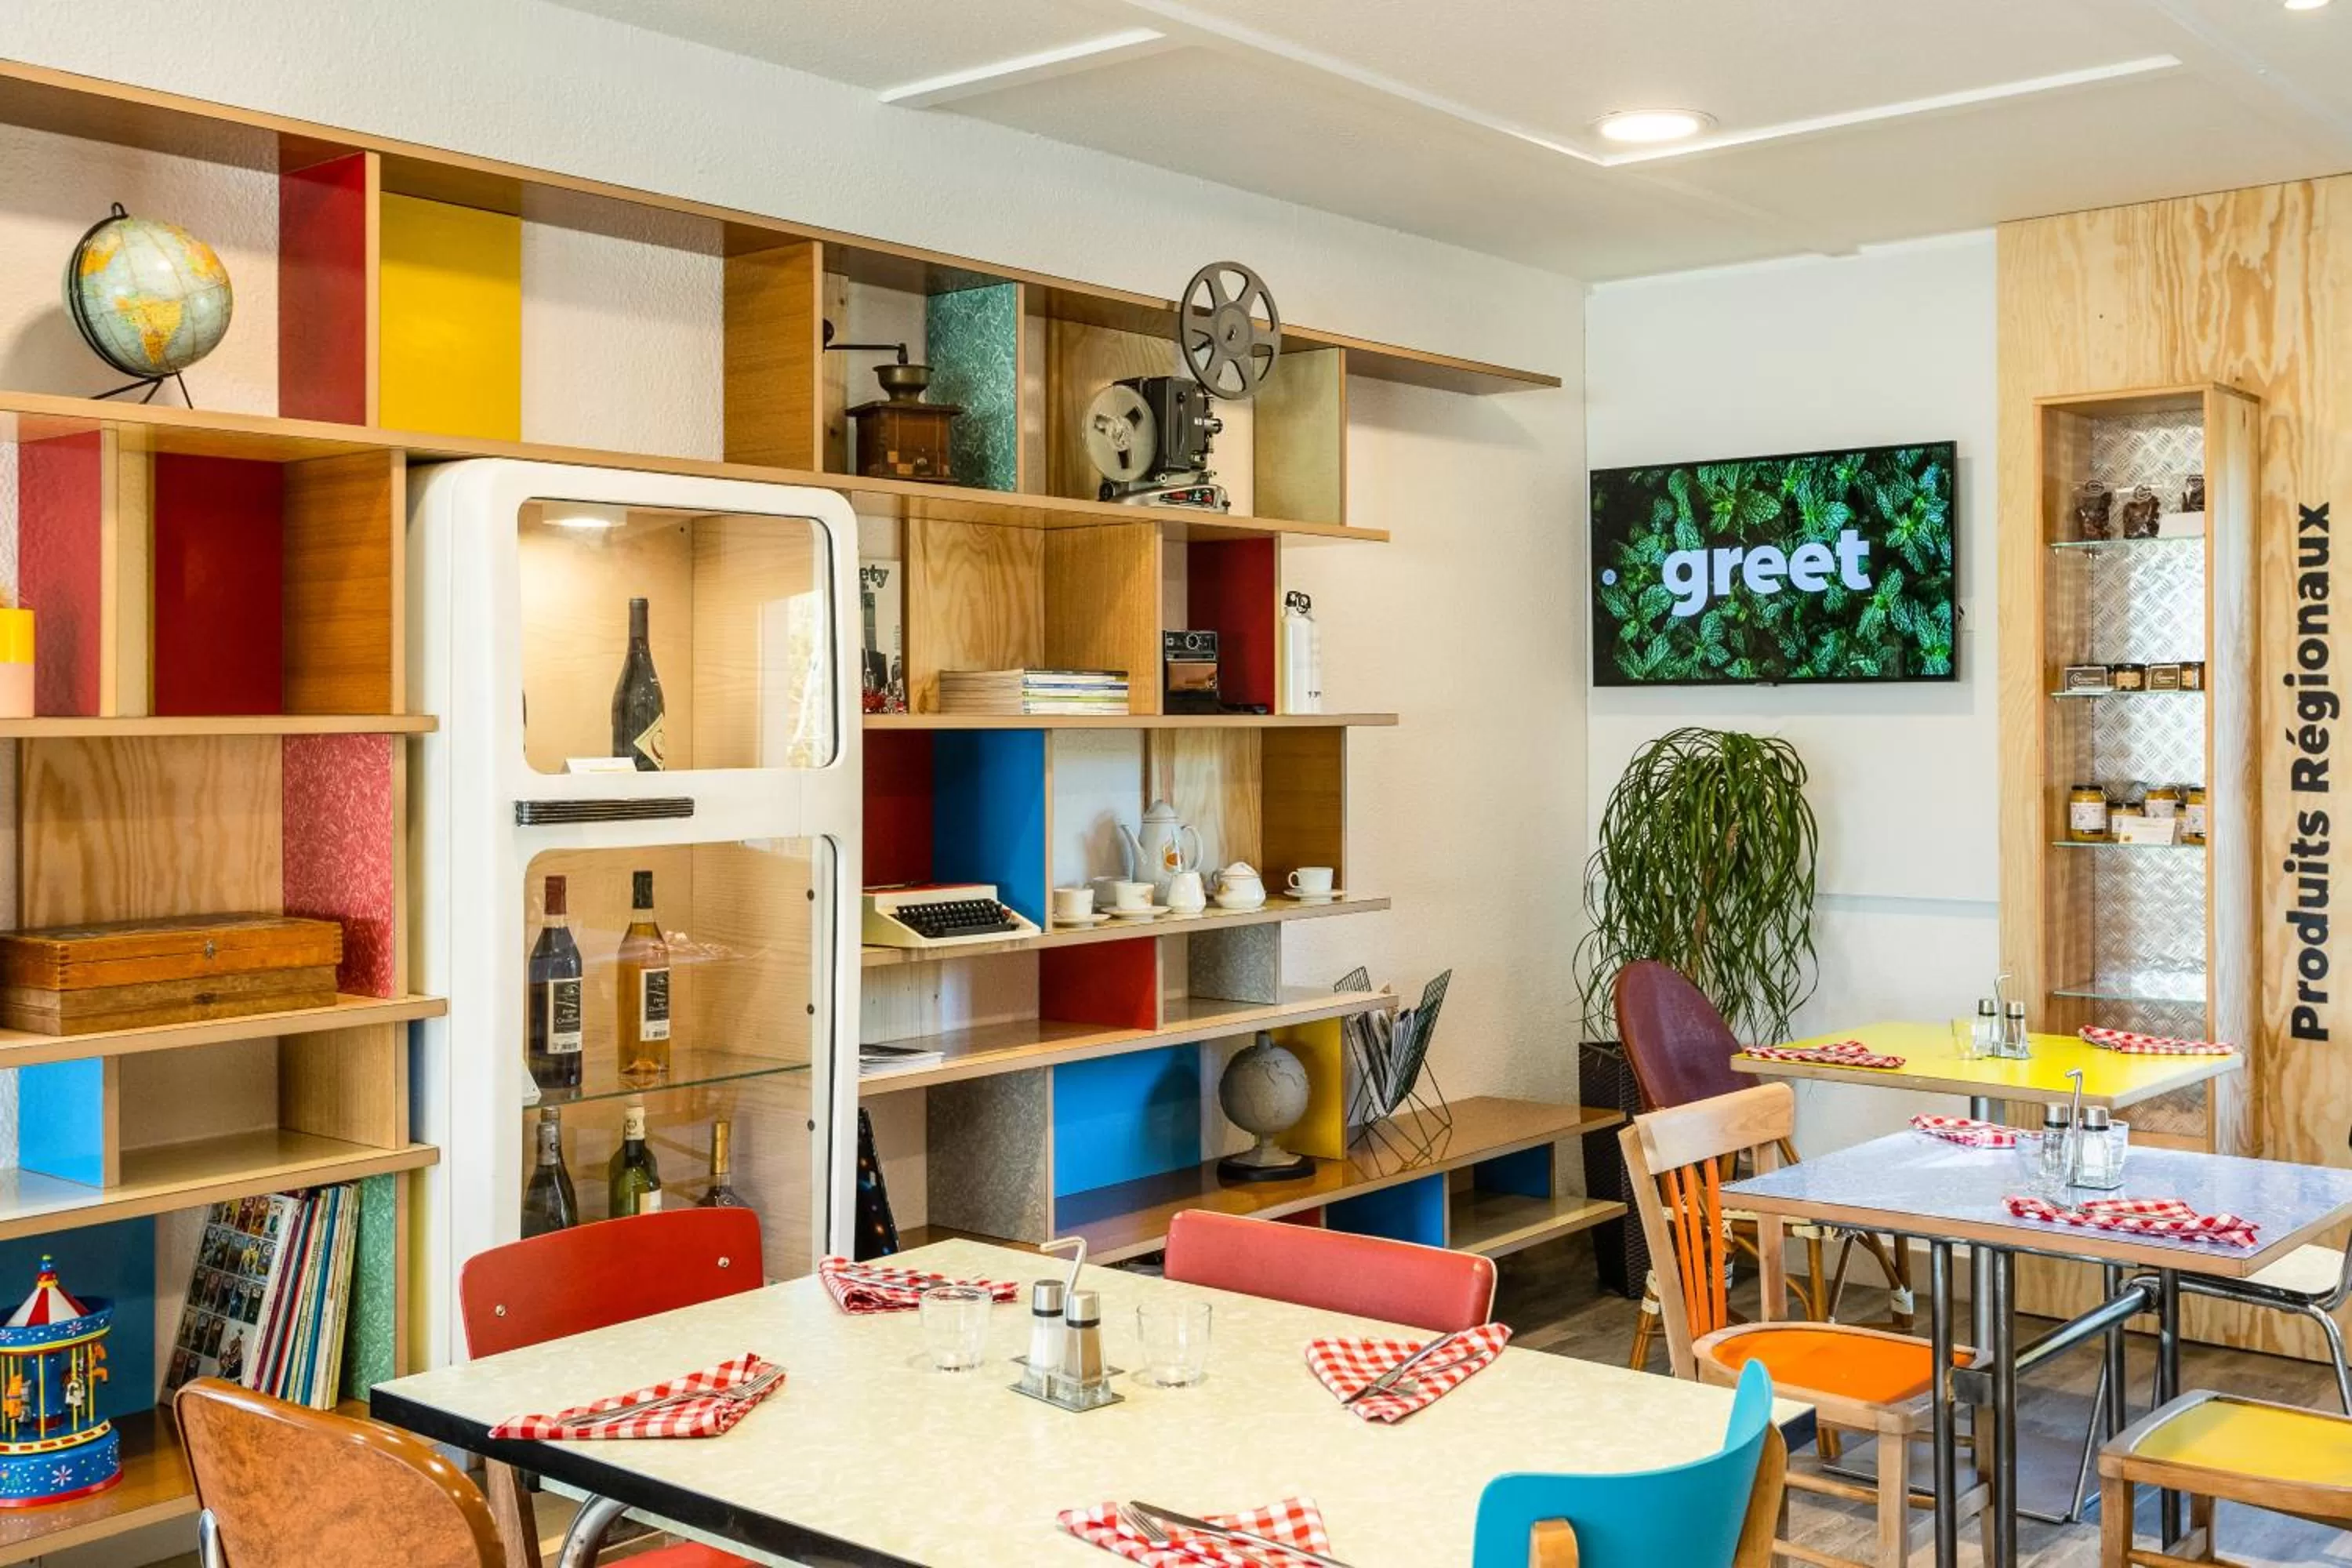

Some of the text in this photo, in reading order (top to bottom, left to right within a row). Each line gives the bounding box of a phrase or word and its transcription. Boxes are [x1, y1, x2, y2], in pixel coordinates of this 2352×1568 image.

[1662, 529, 1871, 616] greet
[2282, 502, 2340, 1042] Produits Régionaux
